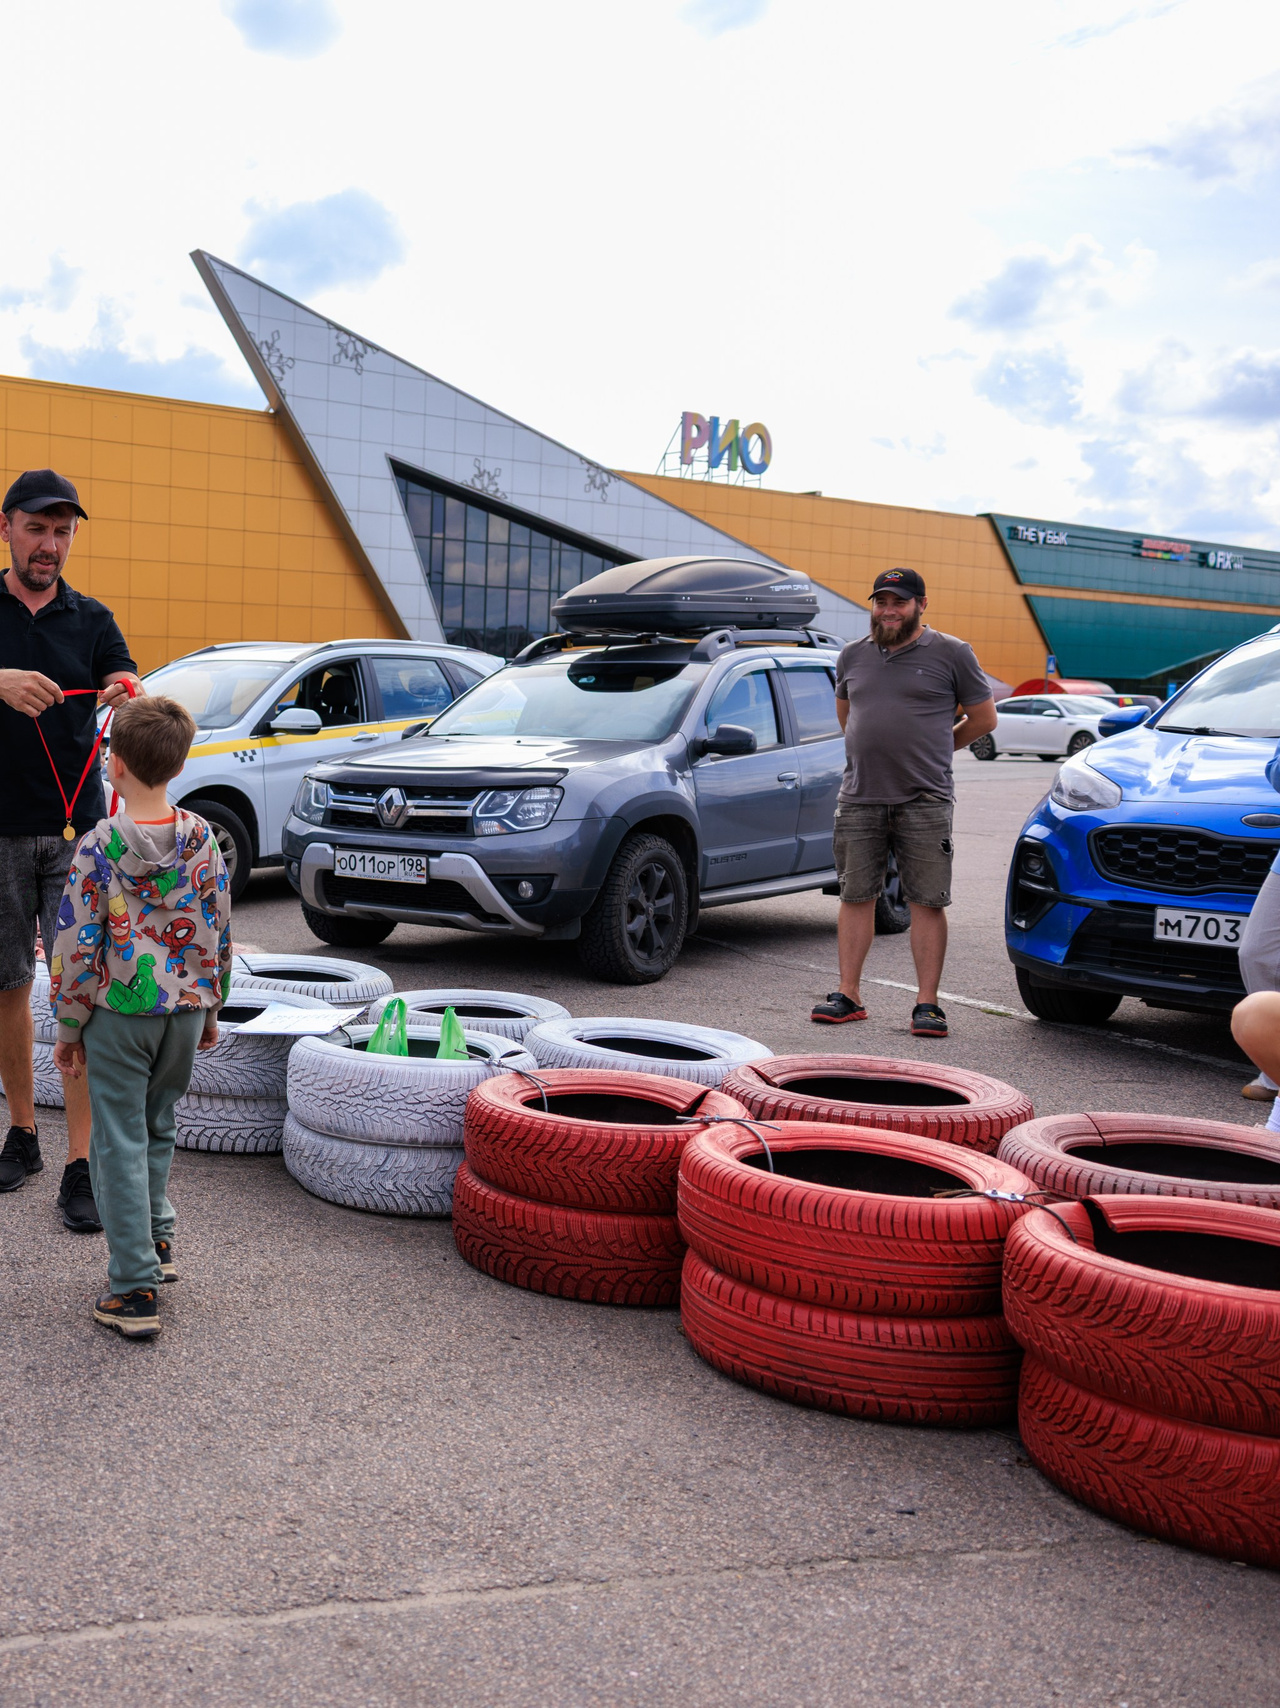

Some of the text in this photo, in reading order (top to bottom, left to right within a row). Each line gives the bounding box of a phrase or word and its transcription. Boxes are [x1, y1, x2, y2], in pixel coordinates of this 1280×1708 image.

[680, 411, 772, 475] РИО
[1017, 525, 1038, 542] THE
[1046, 529, 1068, 545] БЫК
[400, 857, 423, 872] 198
[709, 853, 748, 866] DUSTER
